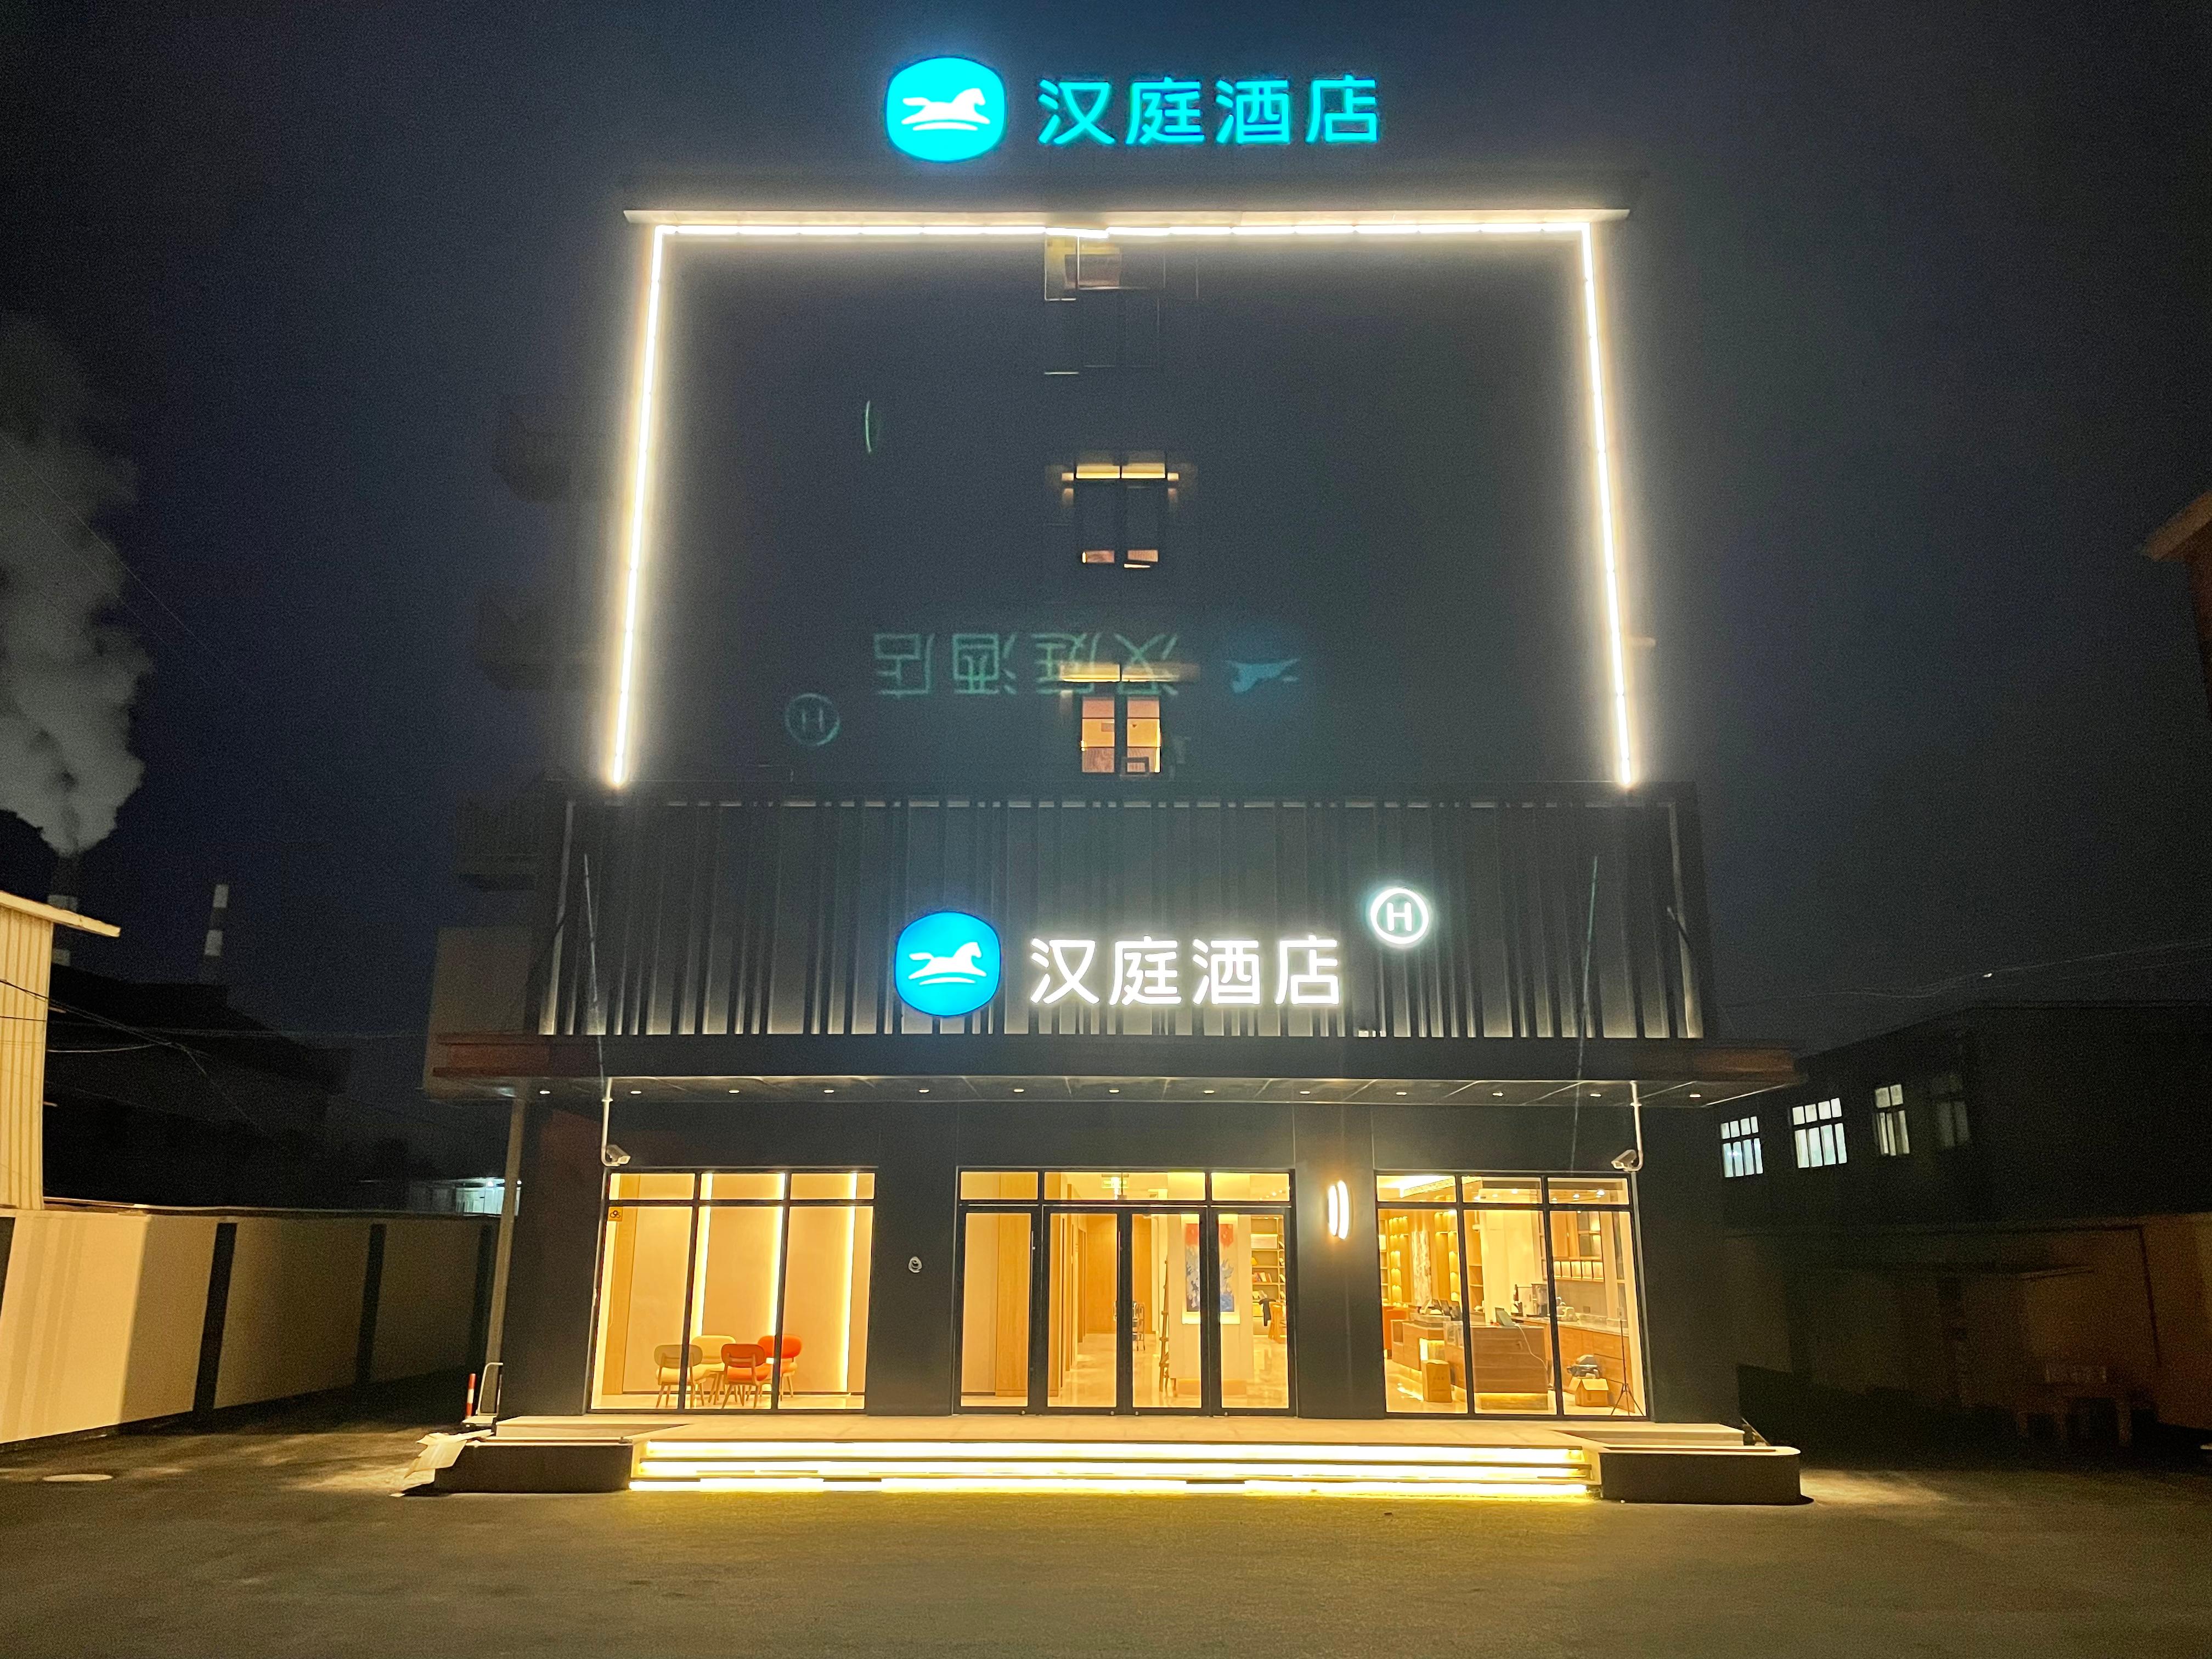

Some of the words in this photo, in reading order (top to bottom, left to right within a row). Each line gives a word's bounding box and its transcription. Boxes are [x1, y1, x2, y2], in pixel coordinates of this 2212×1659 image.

[1037, 75, 1378, 144] 汉庭酒店
[1387, 902, 1413, 932] H
[1030, 934, 1340, 1006] 汉庭酒店
